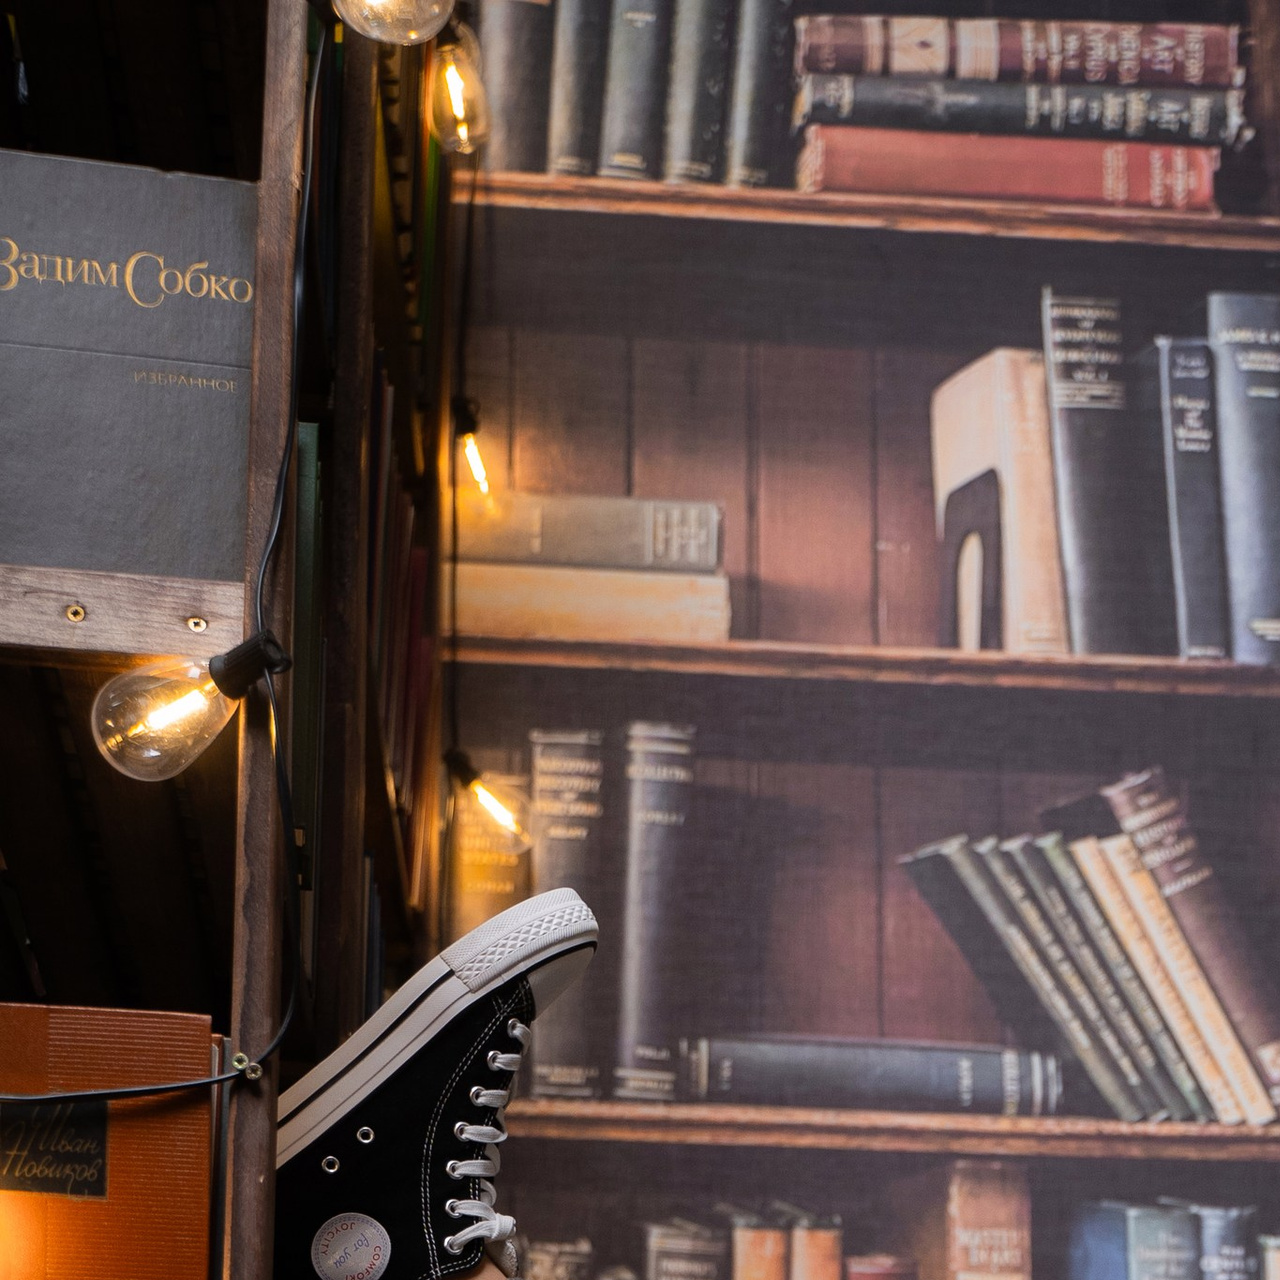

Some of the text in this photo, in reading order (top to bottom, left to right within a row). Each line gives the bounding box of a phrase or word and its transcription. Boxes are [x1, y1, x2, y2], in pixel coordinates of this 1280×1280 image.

[1151, 36, 1177, 74] ART
[1156, 101, 1183, 132] ART
[0, 237, 253, 308] Вадим Собко
[134, 370, 238, 393] ИЗБРАННОЕ
[2, 1121, 103, 1200] Новиков
[320, 1222, 356, 1256] JOYCITY
[333, 1246, 352, 1269] you
